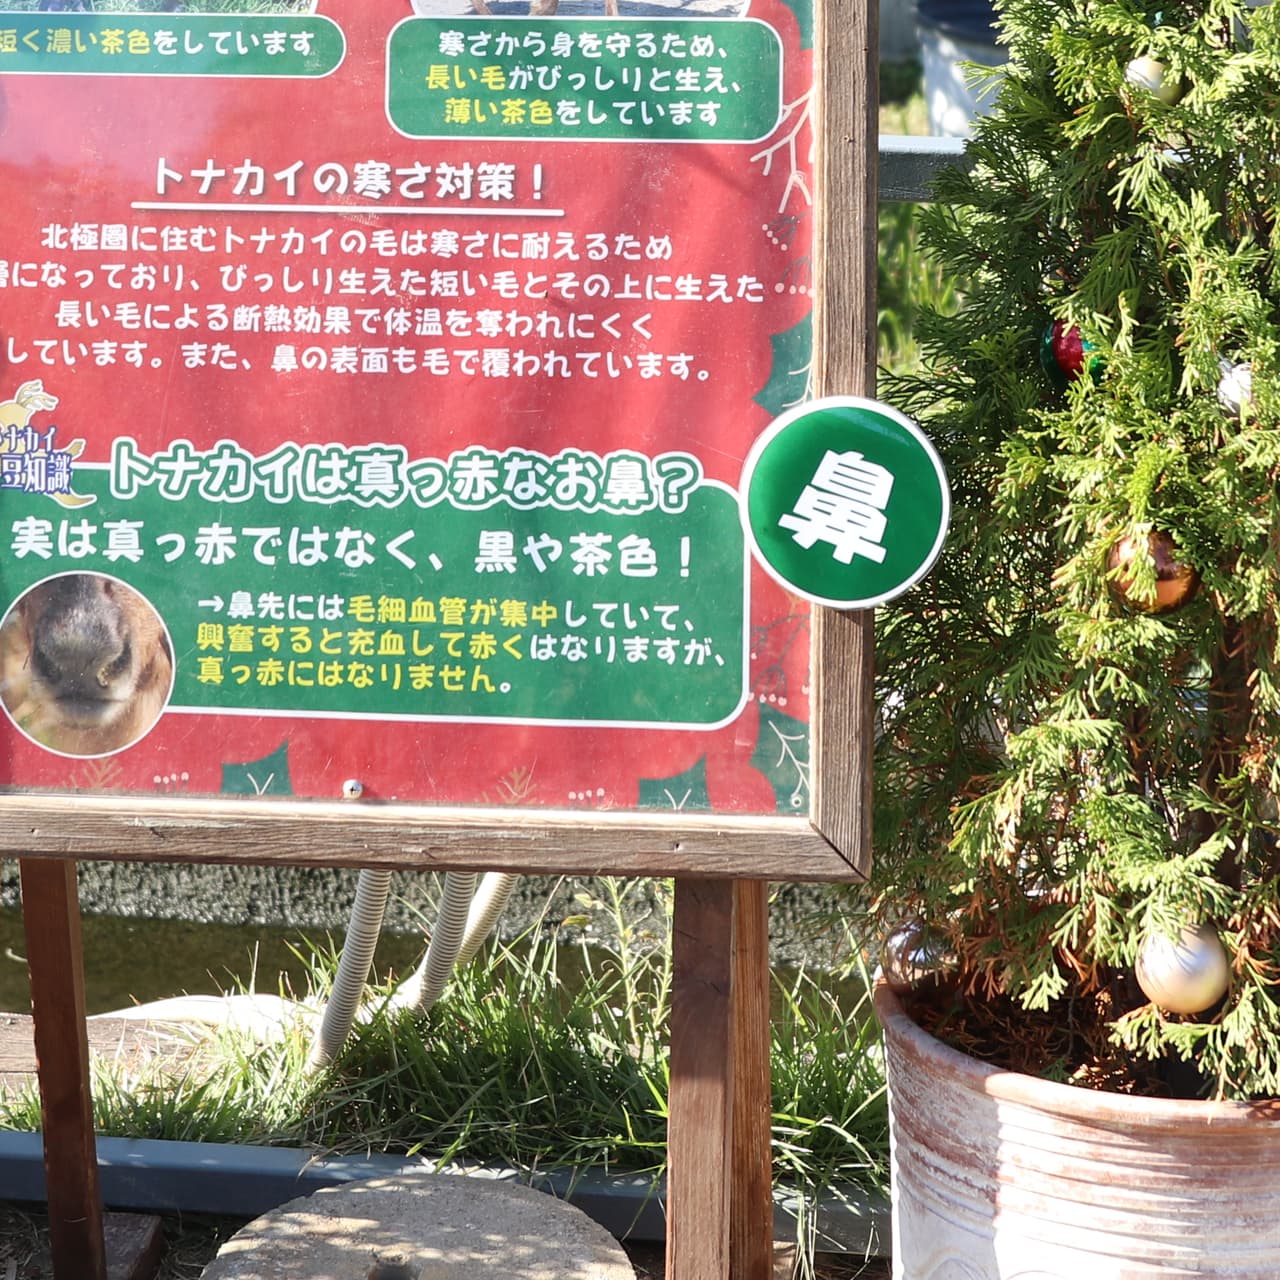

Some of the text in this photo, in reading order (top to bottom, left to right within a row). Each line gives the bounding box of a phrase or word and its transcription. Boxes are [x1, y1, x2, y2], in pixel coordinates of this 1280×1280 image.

[436, 28, 730, 60] 寒さから身を守るため、
[425, 64, 742, 94] 長い毛がびっしりと生え、
[445, 99, 722, 128] 薄い茶色をしています
[155, 157, 546, 201] トナカイの寒さ対策！
[40, 223, 674, 261] 北極圏に住むトナカイの毛は寒さに耐えるため
[54, 300, 654, 342] 長い毛による断熱効果で体温を奪われにくく
[6, 337, 710, 382] しています。また、鼻の表面も毛で覆われています。
[0, 452, 71, 494] 豆知識
[110, 438, 702, 512] トナカイは真っ赤なお鼻？
[778, 449, 895, 565] 鼻
[10, 515, 694, 580] 実は真っ赤ではなく、黒や茶色！
[196, 622, 725, 668] 興奮すると充血して赤くはなりますが、
[196, 657, 512, 694] 真っ赤にはなりません。
